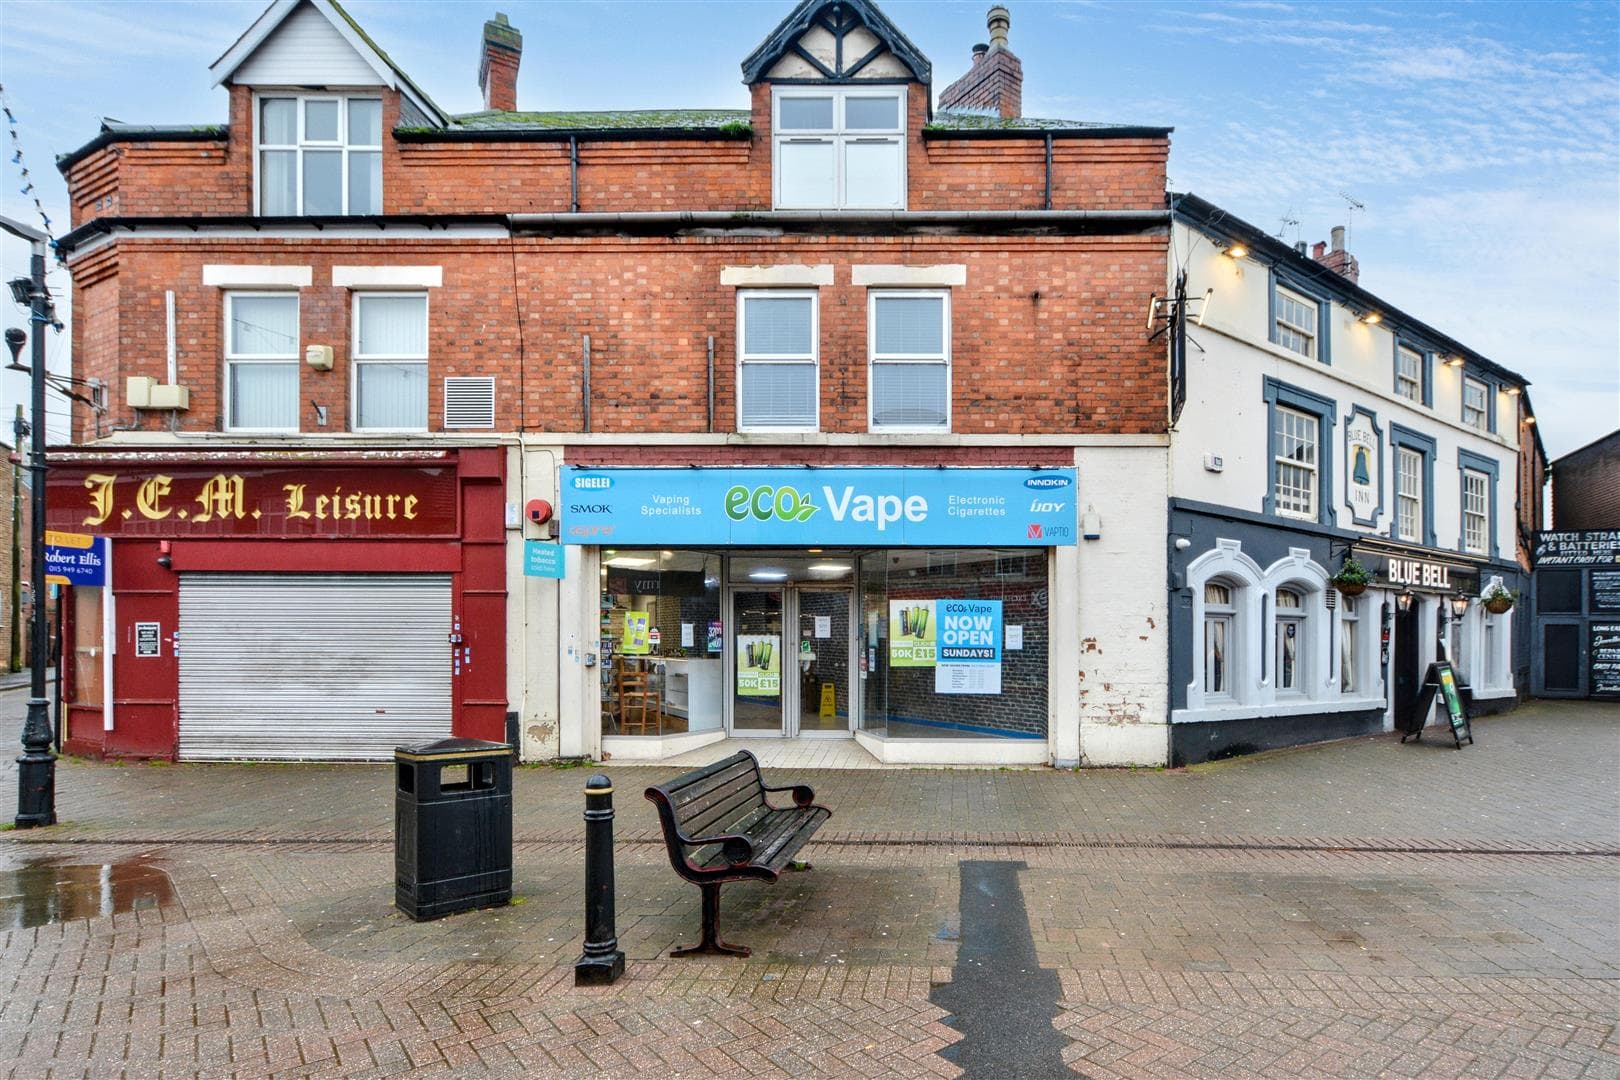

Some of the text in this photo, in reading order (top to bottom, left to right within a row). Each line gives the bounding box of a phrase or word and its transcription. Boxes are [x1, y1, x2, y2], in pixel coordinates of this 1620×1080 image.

[1347, 430, 1376, 449] BLUE BELL
[575, 477, 610, 488] SIGELEI
[82, 474, 418, 526] J.E.M. Leisure
[652, 495, 690, 506] Vaping
[948, 495, 1006, 505] Electronic
[1355, 489, 1370, 504] INN
[570, 504, 613, 513] SMOK
[641, 505, 702, 516] Specialists
[724, 485, 929, 531] eco Vape
[947, 506, 1006, 517] Cigarettes
[1540, 533, 1579, 542] WATCH
[1547, 541, 1557, 551] &
[79, 552, 102, 567] Ellis
[1596, 555, 1614, 563] FOR
[48, 565, 61, 573] 0115
[76, 567, 93, 575] 6740
[1389, 558, 1451, 589] BLUE BELL
[946, 603, 992, 614] eco Vape
[944, 616, 992, 630] NOW
[943, 630, 994, 645] OPEN
[892, 648, 936, 658] 50K £15
[943, 648, 993, 658] SUNDAYS!
[739, 679, 757, 688] 50K
